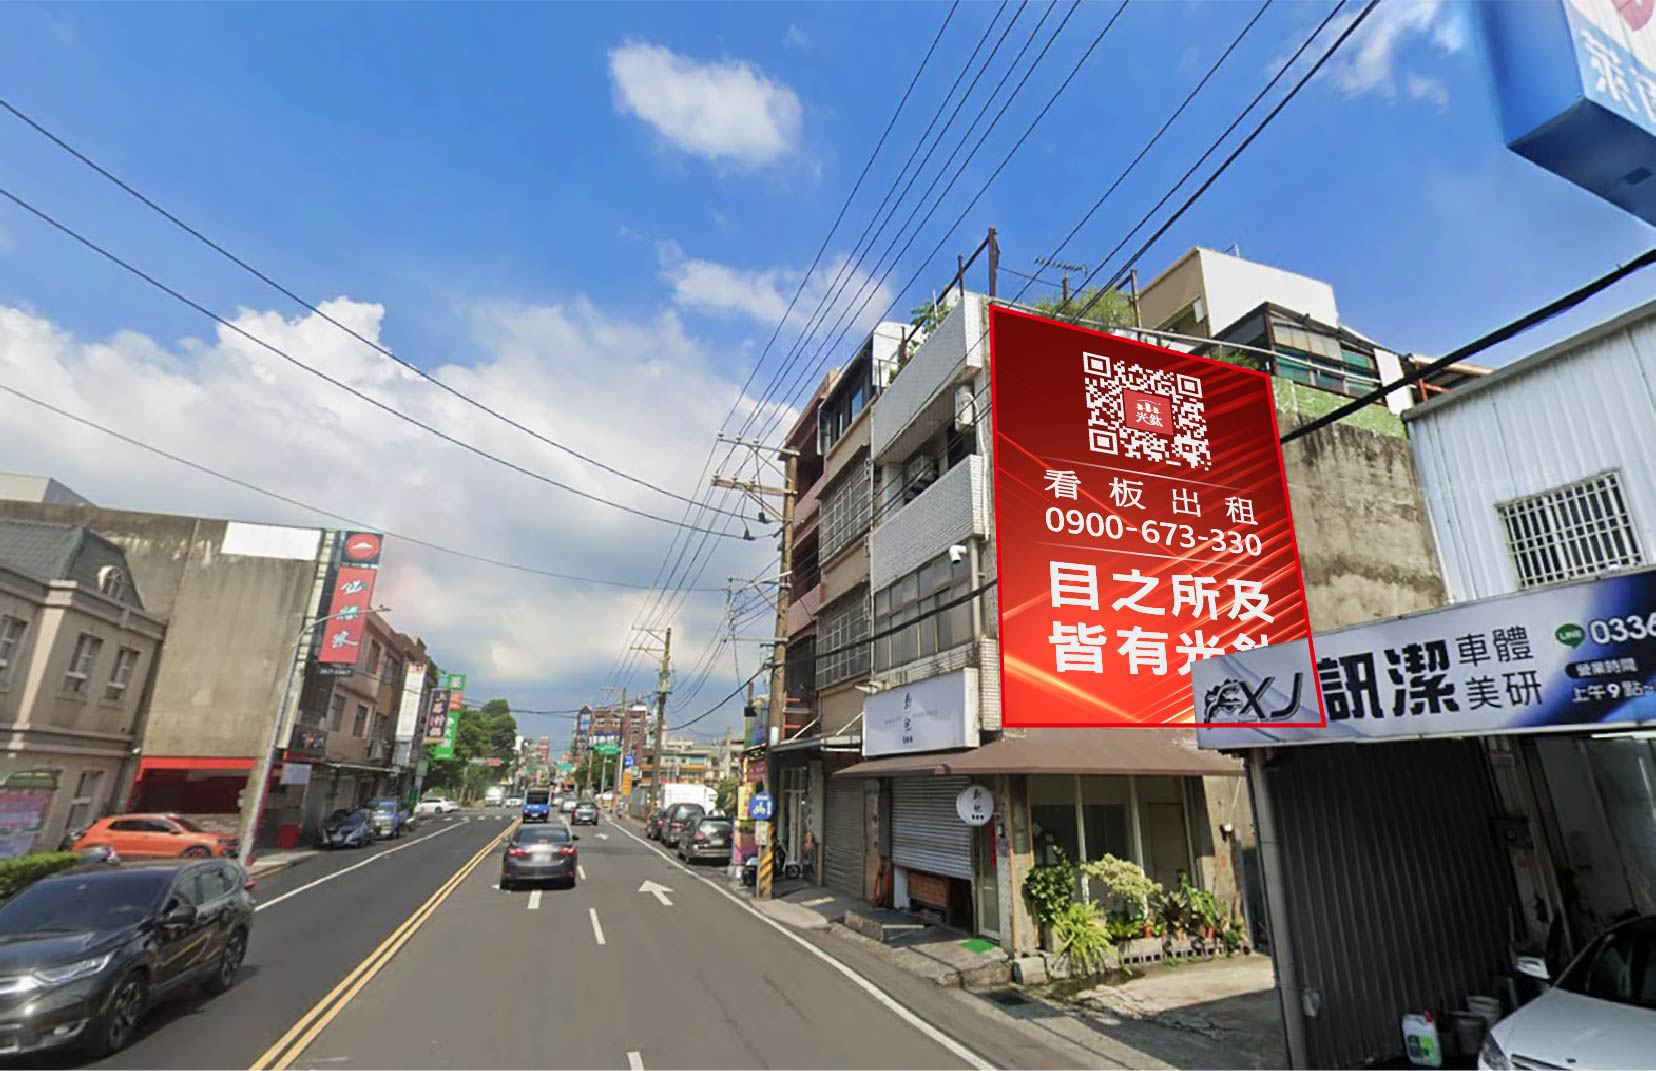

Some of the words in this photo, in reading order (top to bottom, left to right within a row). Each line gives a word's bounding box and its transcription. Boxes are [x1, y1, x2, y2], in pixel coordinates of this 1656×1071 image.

[1043, 469, 1259, 526] 看板出租
[1044, 506, 1262, 557] 0900-673-330
[1048, 561, 1276, 624] 目之所及
[1455, 625, 1535, 668] 車體
[1318, 639, 1460, 721] 訊潔
[1466, 669, 1543, 712] 美研
